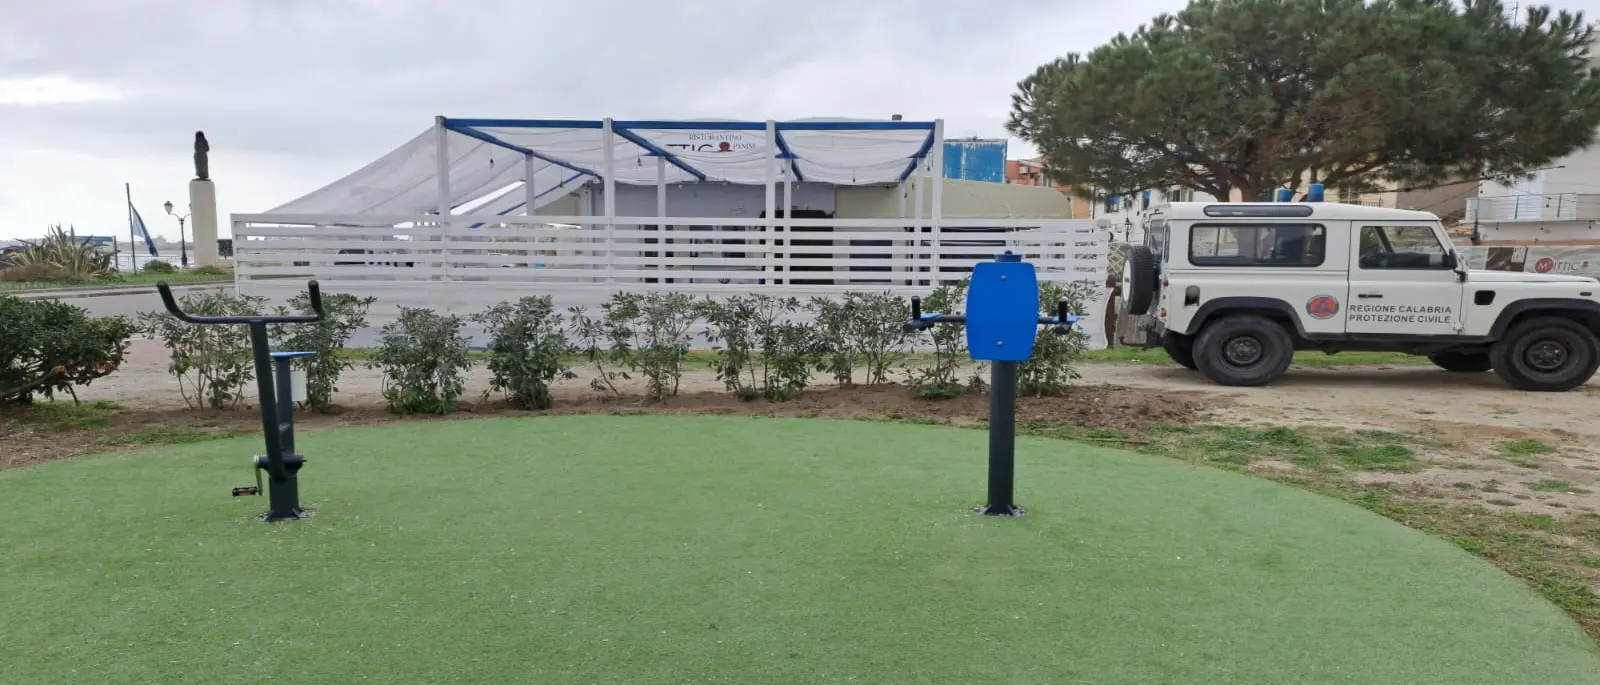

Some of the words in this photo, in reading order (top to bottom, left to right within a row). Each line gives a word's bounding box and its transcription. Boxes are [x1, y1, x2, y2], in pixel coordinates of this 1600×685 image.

[1349, 304, 1396, 313] REGIONE
[1398, 305, 1452, 314] CALABRIA
[1349, 314, 1415, 323] PROTEZIONE
[1417, 315, 1452, 324] CIVILE
